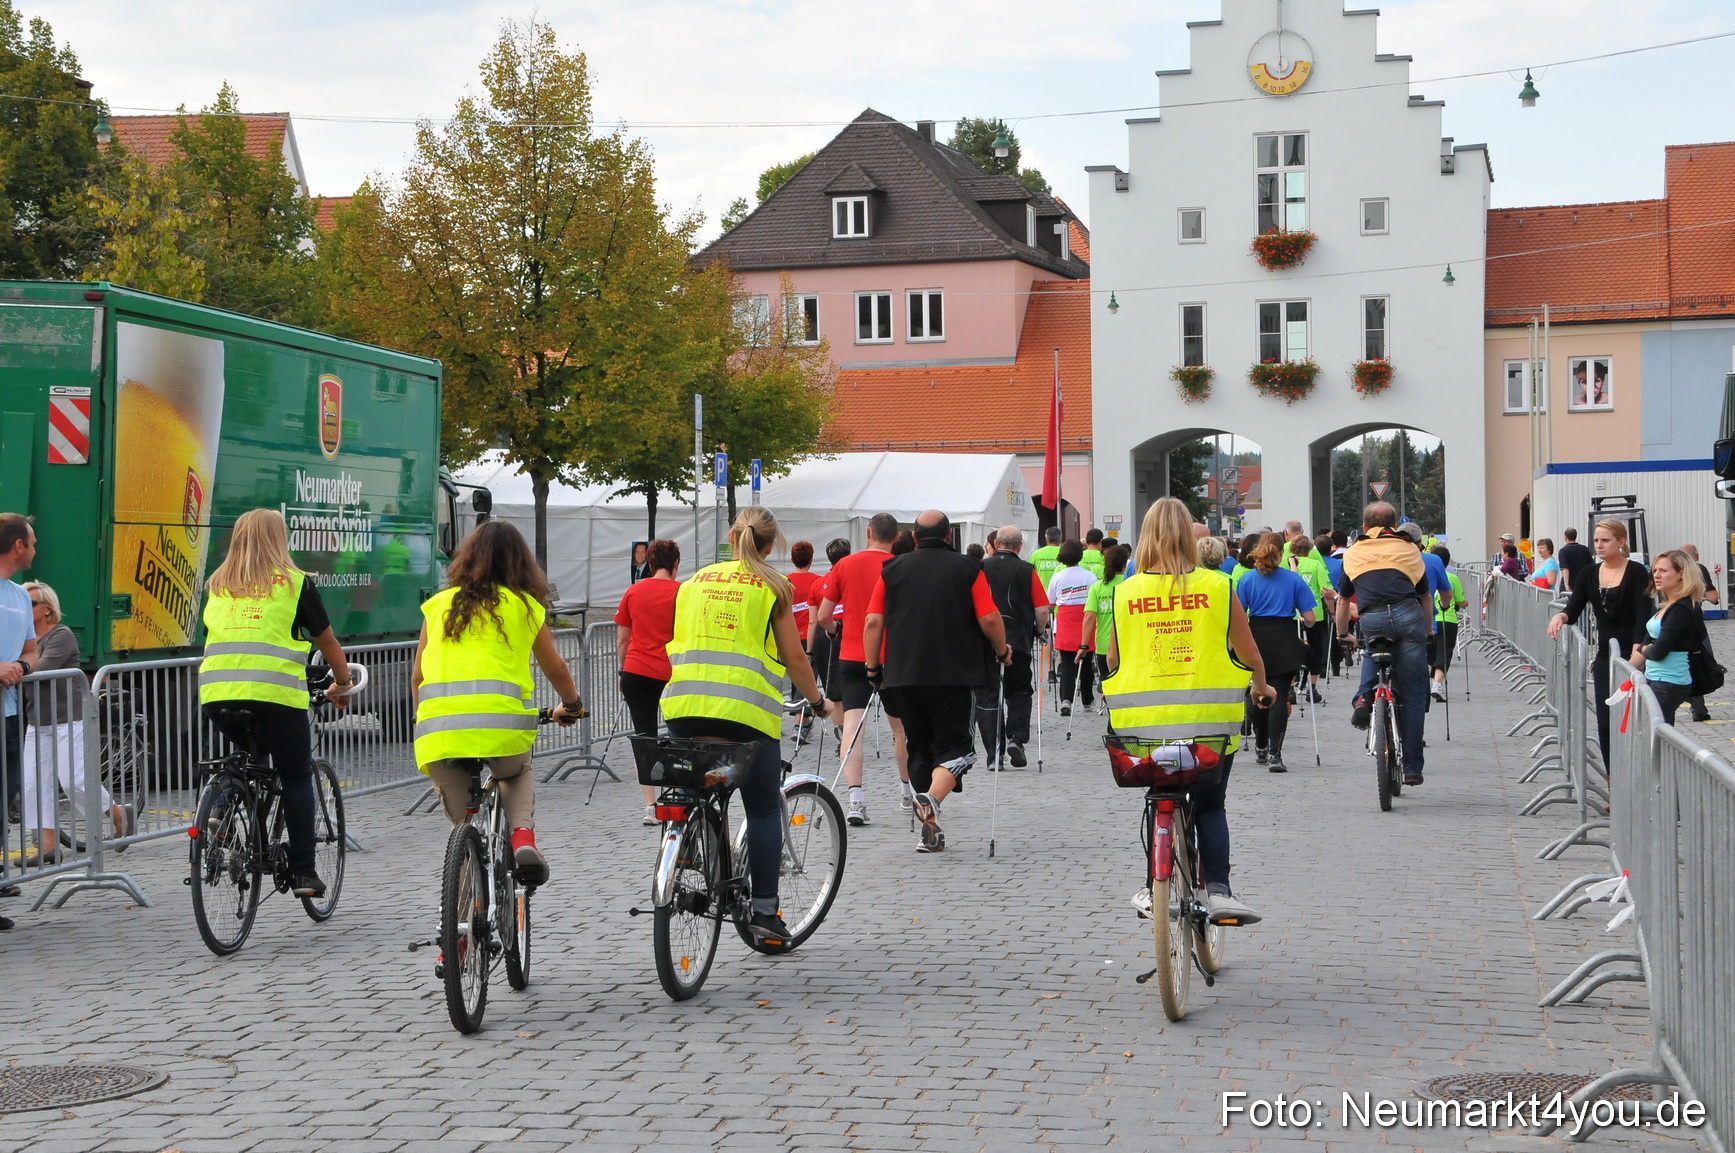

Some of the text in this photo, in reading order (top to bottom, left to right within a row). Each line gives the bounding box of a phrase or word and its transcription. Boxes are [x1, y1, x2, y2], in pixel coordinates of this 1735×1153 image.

[1289, 81, 1297, 89] 14
[1301, 66, 1309, 74] 16
[717, 457, 725, 482] P
[753, 463, 760, 487] P
[295, 469, 362, 506] Neumarkter
[315, 572, 371, 587] ÖKOLOGISCHE BIER
[693, 572, 763, 588] HELFER
[702, 589, 743, 597] NEUMARKTER
[707, 594, 742, 603] STADTLAUF
[1128, 593, 1210, 615] HELFER
[1146, 619, 1192, 629] NEUMARKTER
[1155, 626, 1192, 635] STADTLAUF
